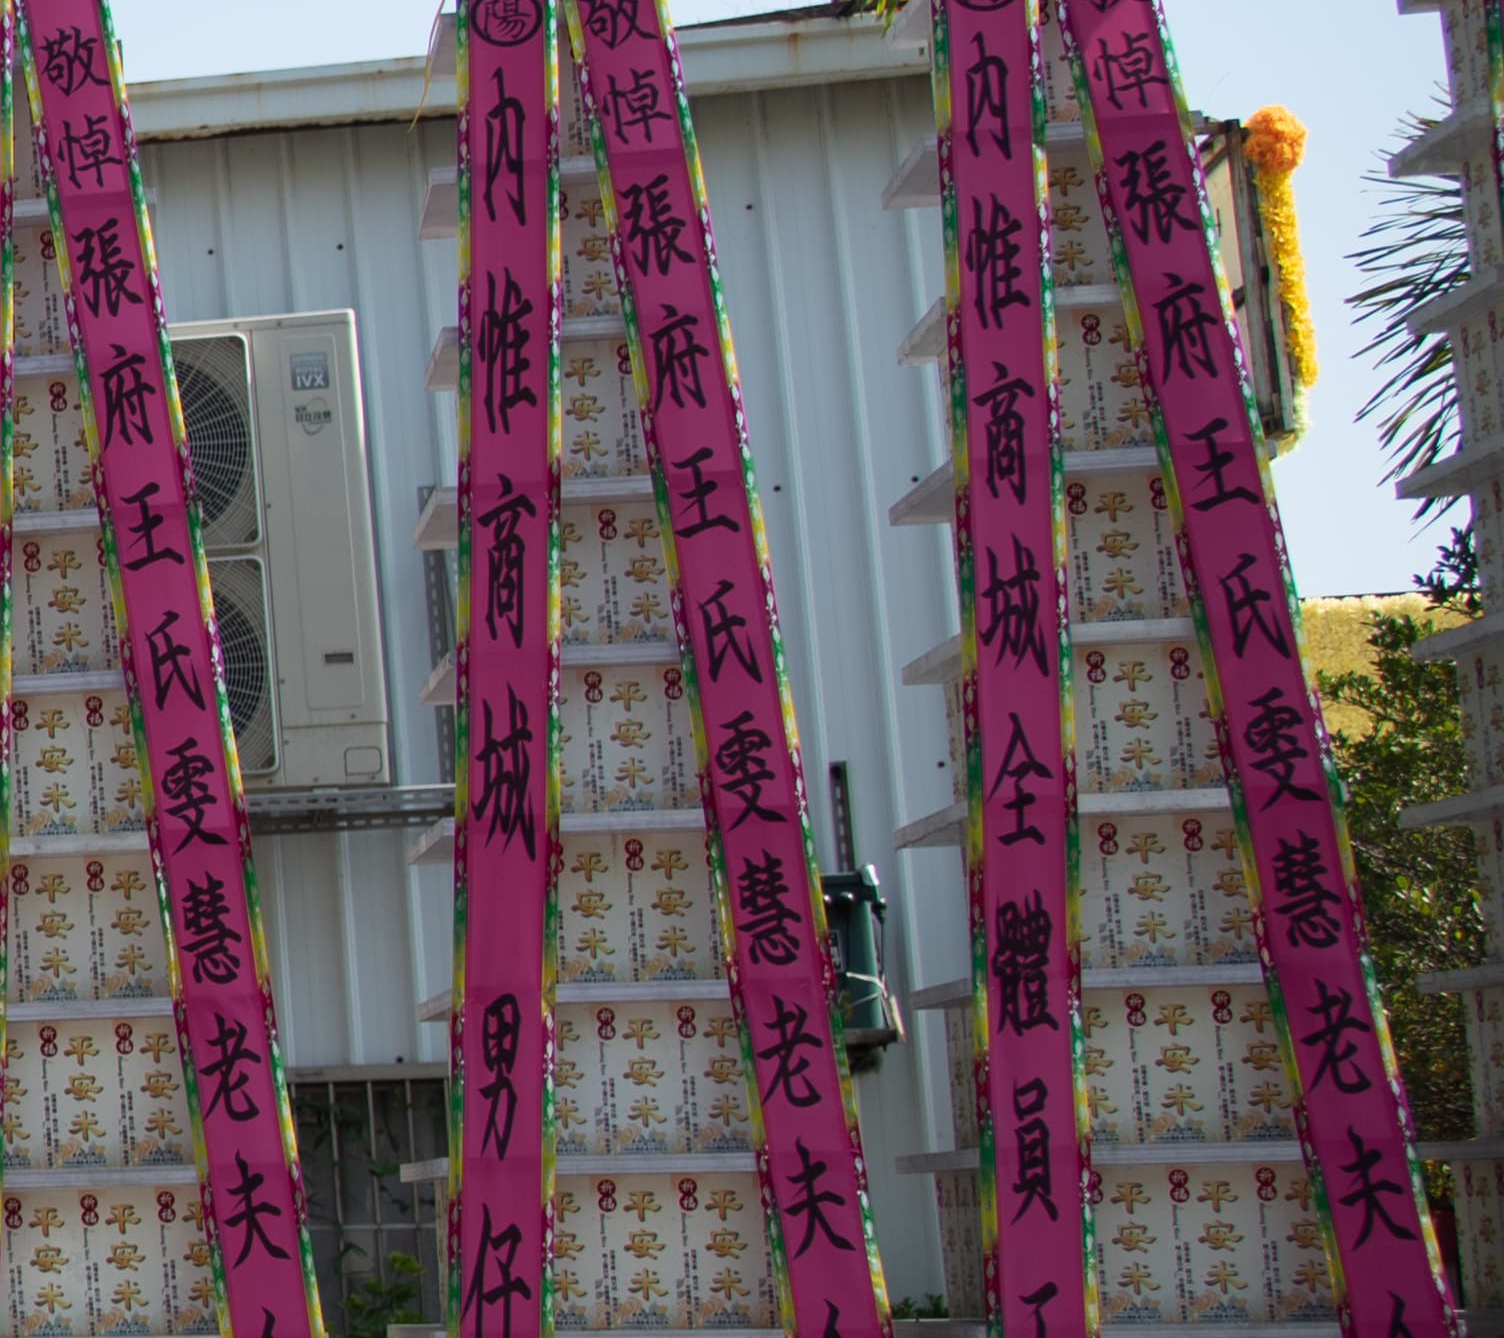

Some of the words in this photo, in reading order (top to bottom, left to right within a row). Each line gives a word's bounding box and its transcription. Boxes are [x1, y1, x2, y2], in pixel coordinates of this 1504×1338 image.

[296, 374, 326, 388] IVX
[598, 509, 616, 539] 祈福
[1114, 660, 1161, 769] 平安米
[650, 848, 697, 957] 平安米
[1211, 989, 1232, 1024] 祈福
[622, 1017, 669, 1126] 平安米
[80, 1195, 98, 1225] 祈福
[1168, 1168, 1189, 1203] 祈福
[1255, 1166, 1276, 1201] 祈福
[104, 1202, 151, 1311] 平安米
[623, 1190, 670, 1299] 平安米
[1197, 1177, 1248, 1295] 平安米
